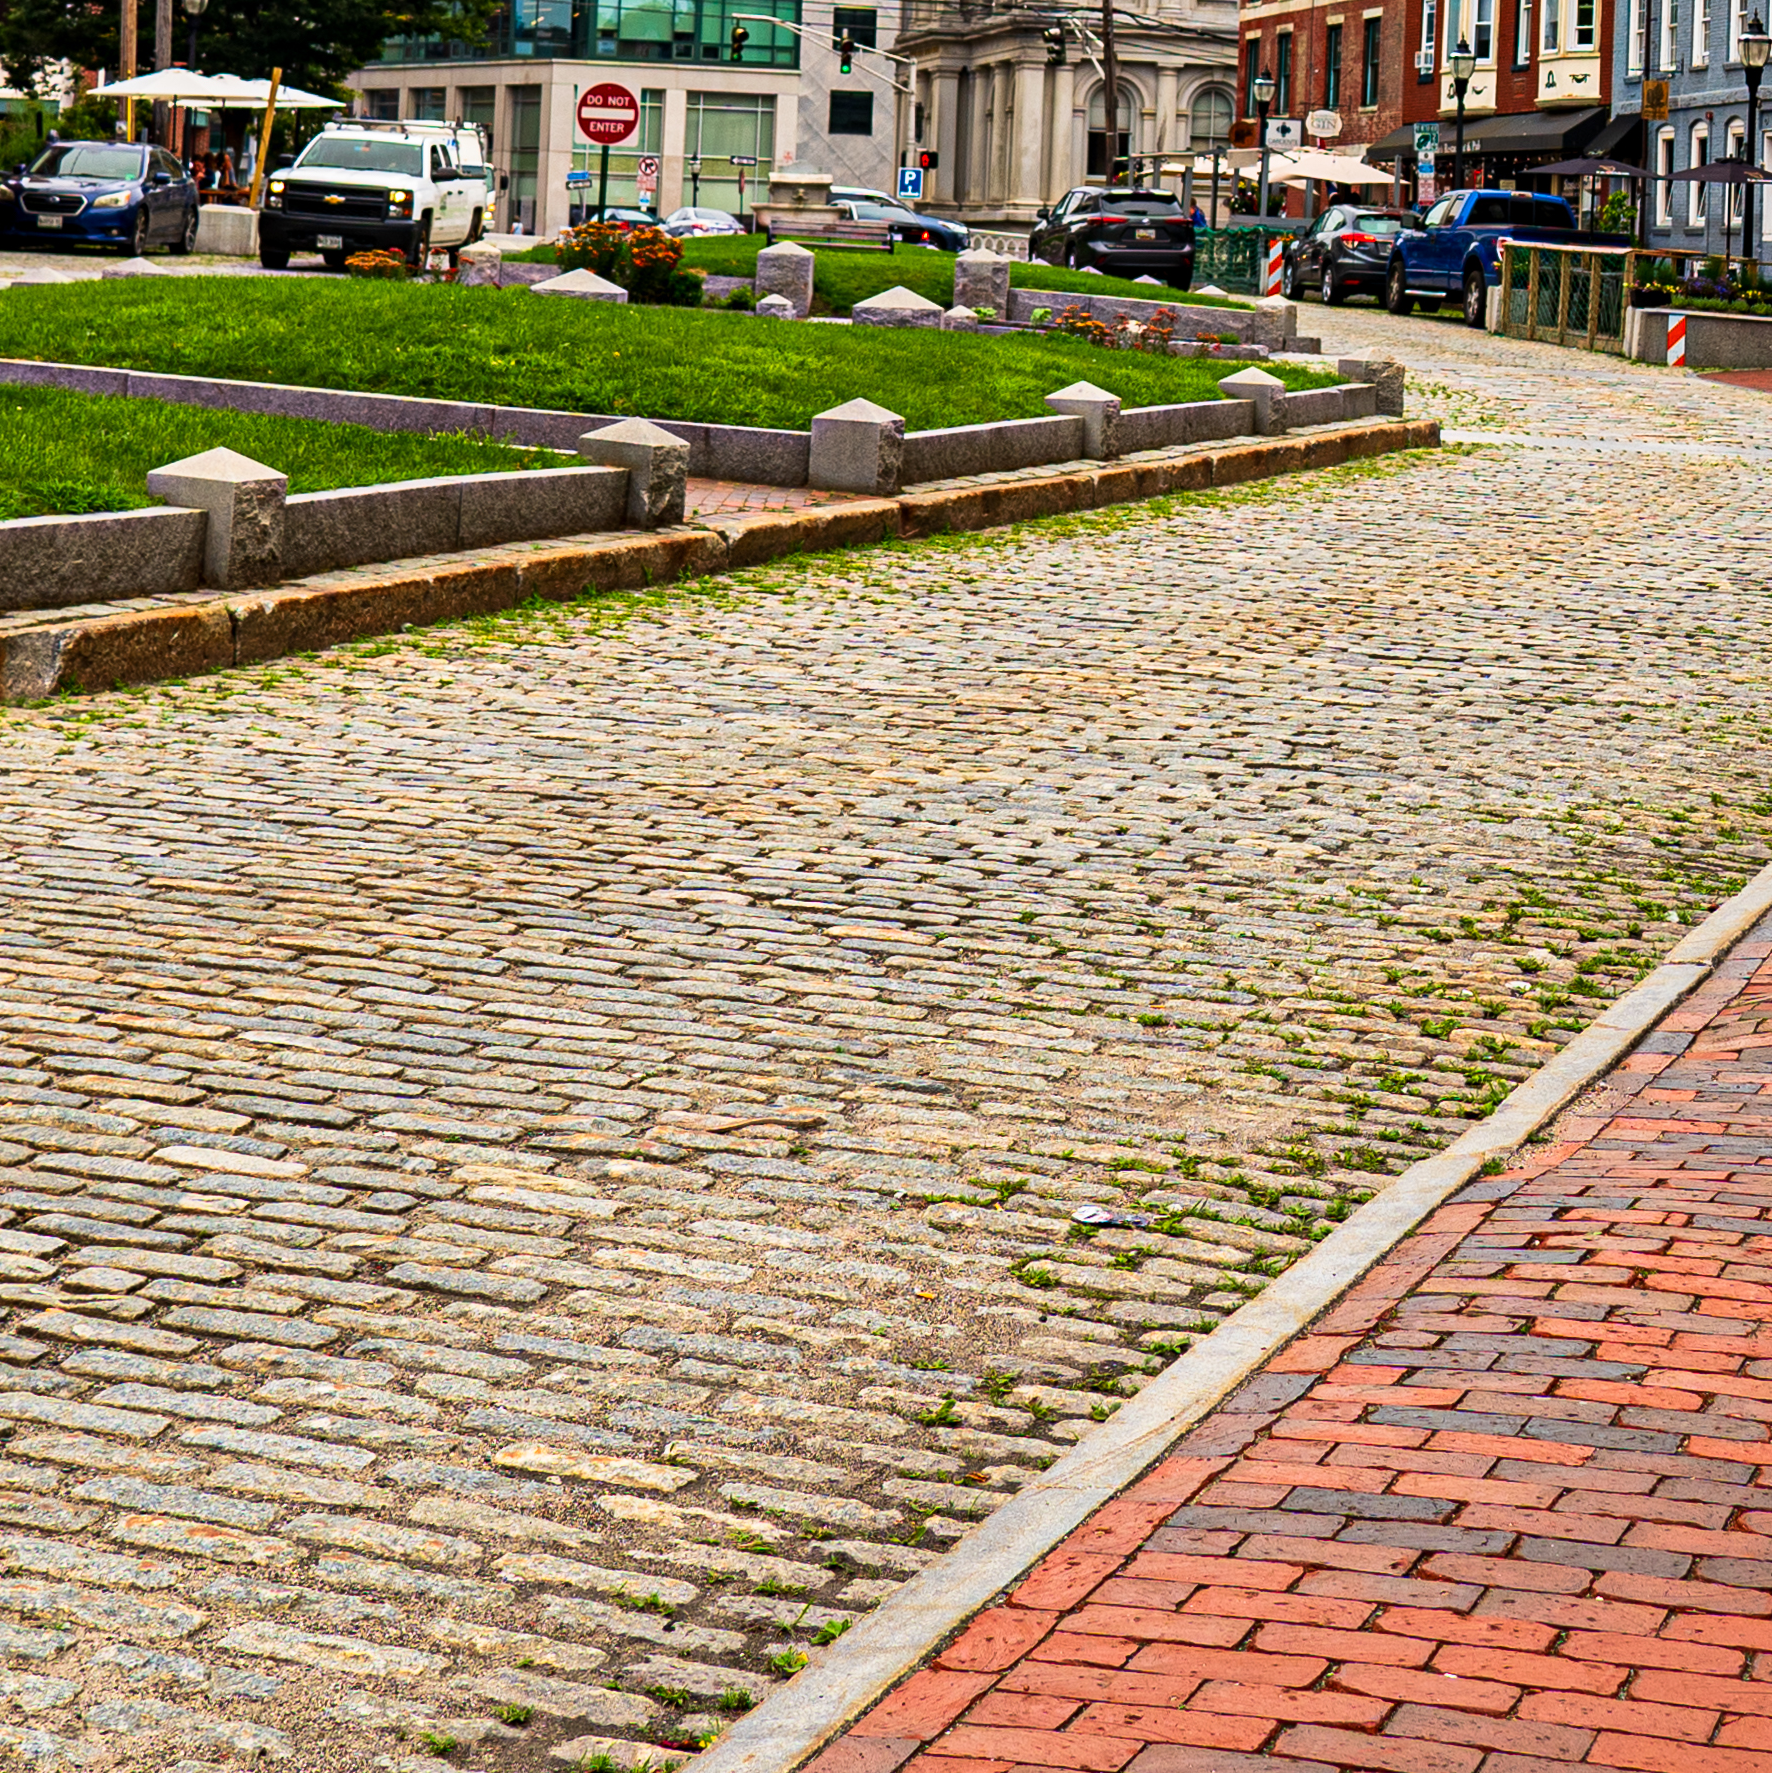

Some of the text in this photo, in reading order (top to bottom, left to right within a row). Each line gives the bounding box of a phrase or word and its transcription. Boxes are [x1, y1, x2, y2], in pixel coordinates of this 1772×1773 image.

[587, 94, 631, 107] DO NOT
[589, 121, 625, 133] ENTER
[1311, 118, 1337, 129] GIN
[904, 171, 917, 185] P
